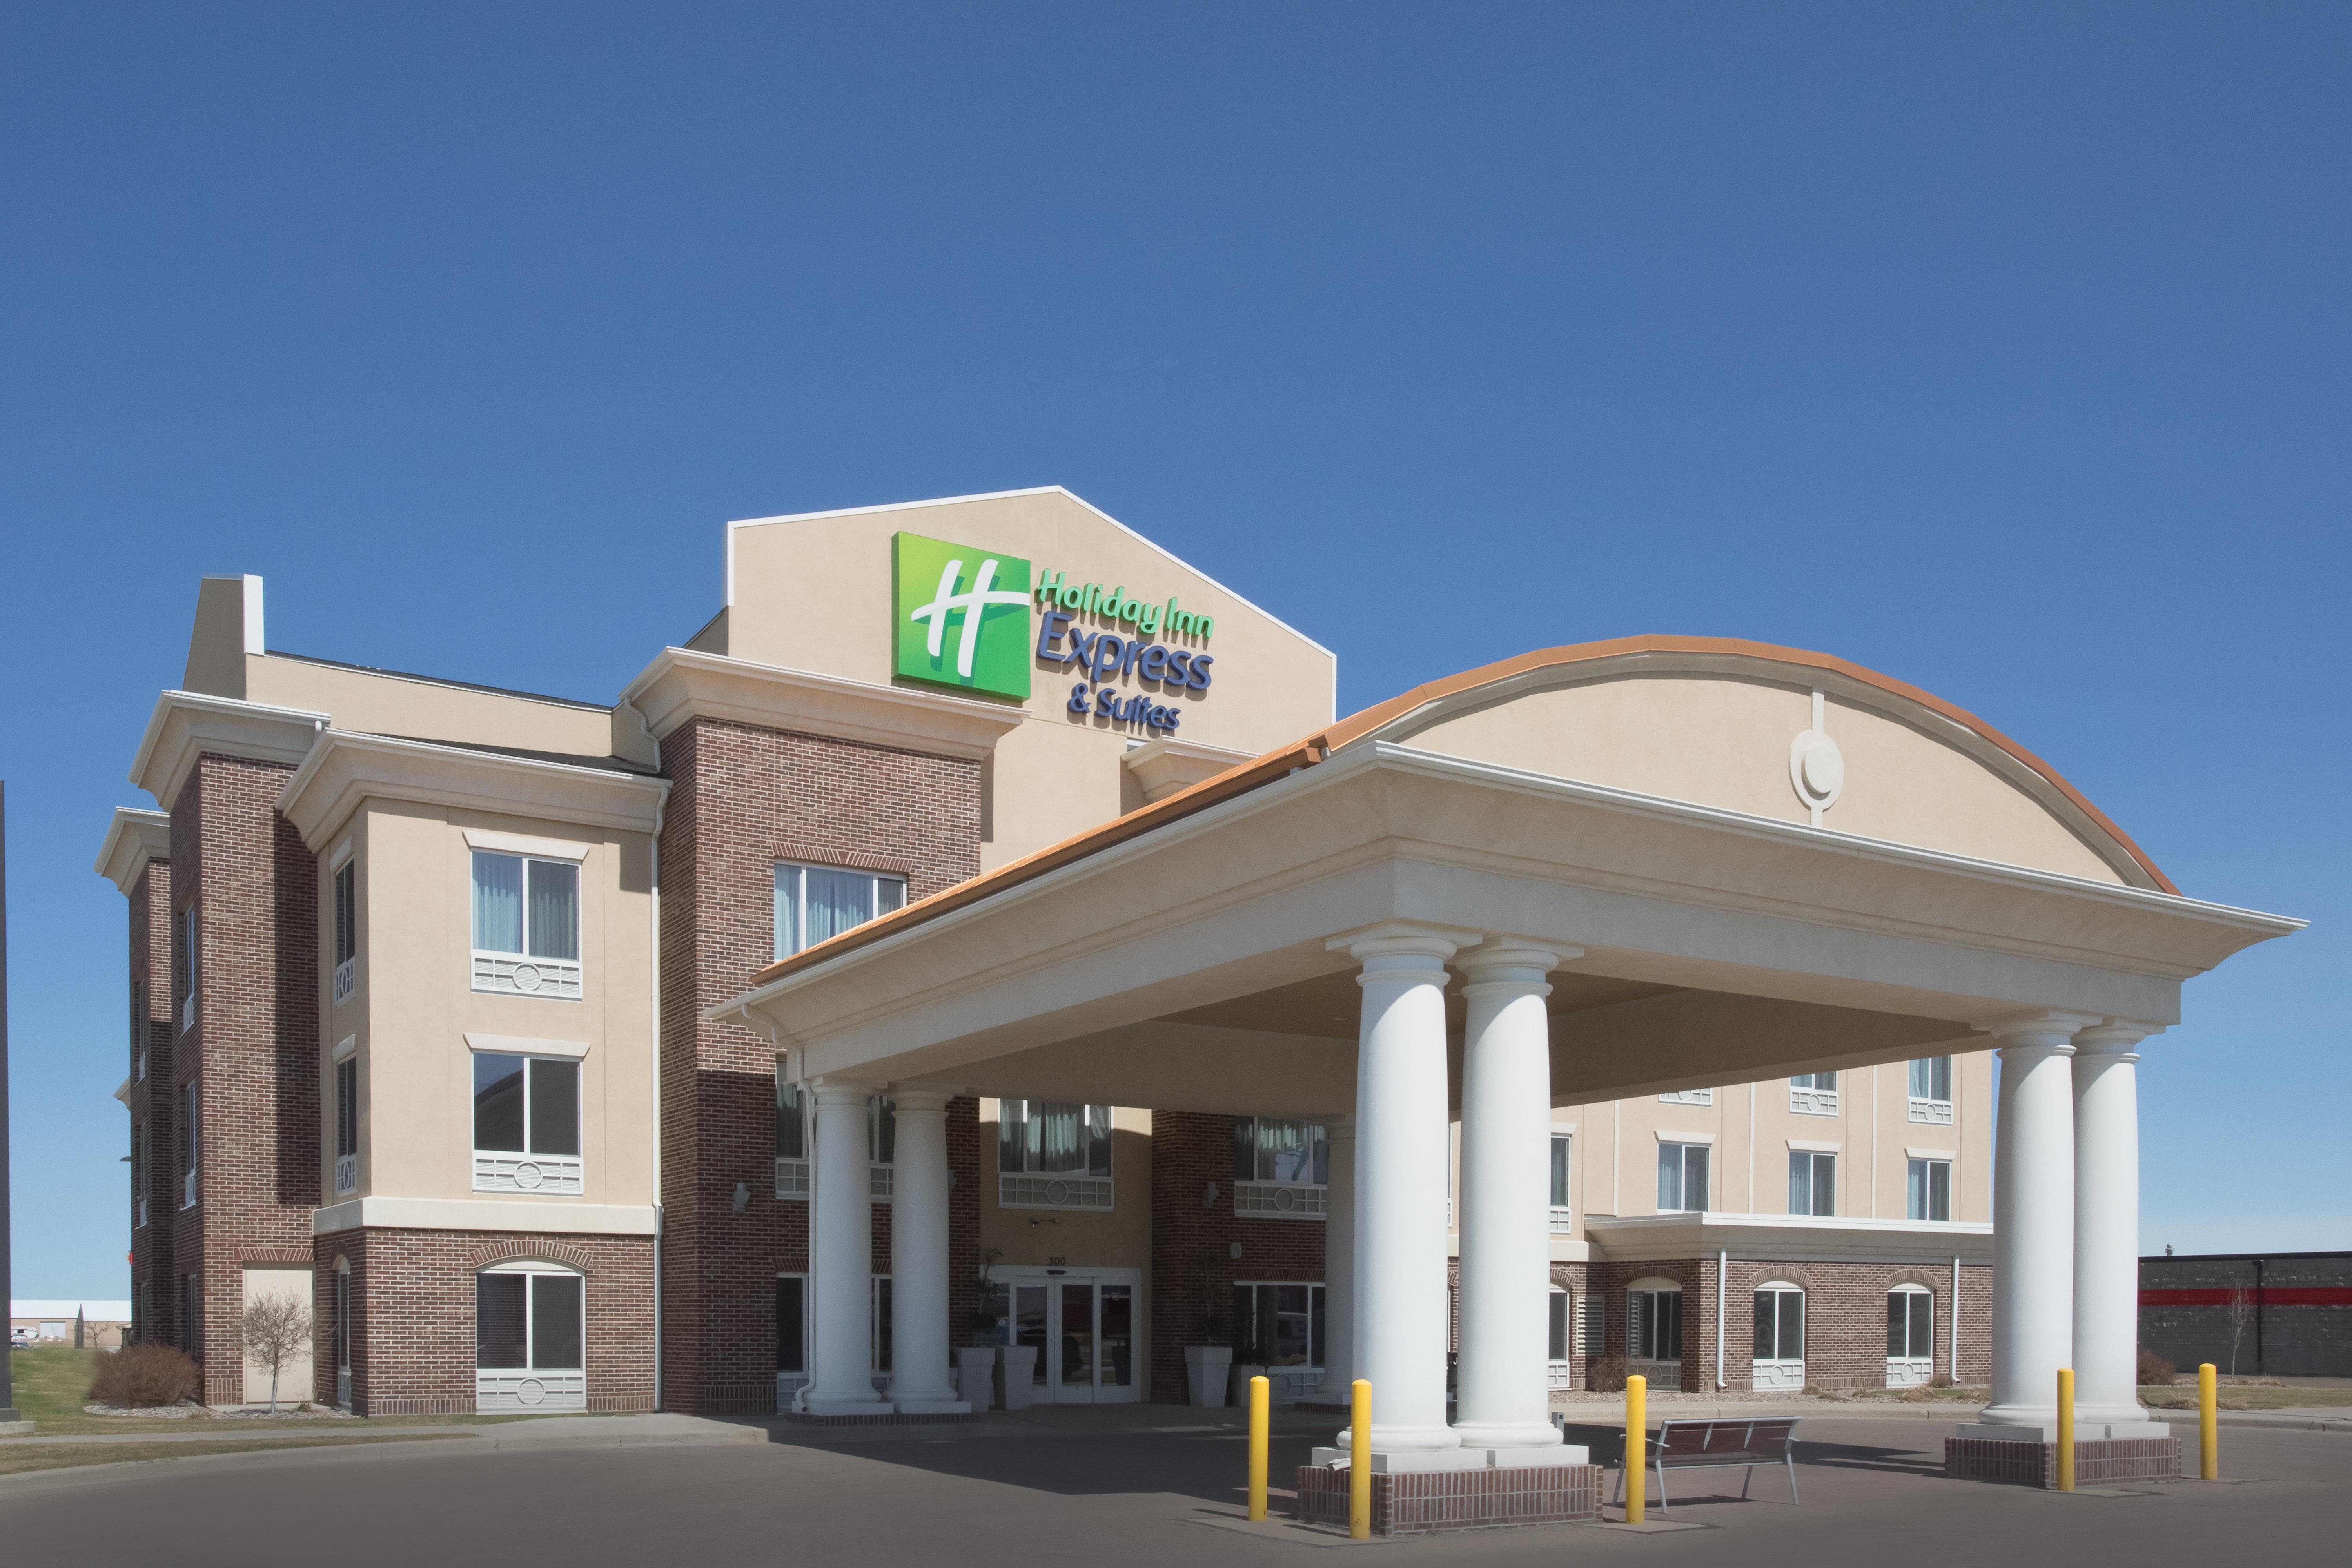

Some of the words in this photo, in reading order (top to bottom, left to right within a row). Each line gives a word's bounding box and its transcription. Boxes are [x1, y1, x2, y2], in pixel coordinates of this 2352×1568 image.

[1035, 568, 1163, 634] Holiday
[1164, 597, 1214, 639] Inn
[1036, 610, 1214, 690] Express
[1067, 683, 1091, 713] &
[1094, 688, 1181, 730] Suites
[1048, 1257, 1066, 1266] 300
